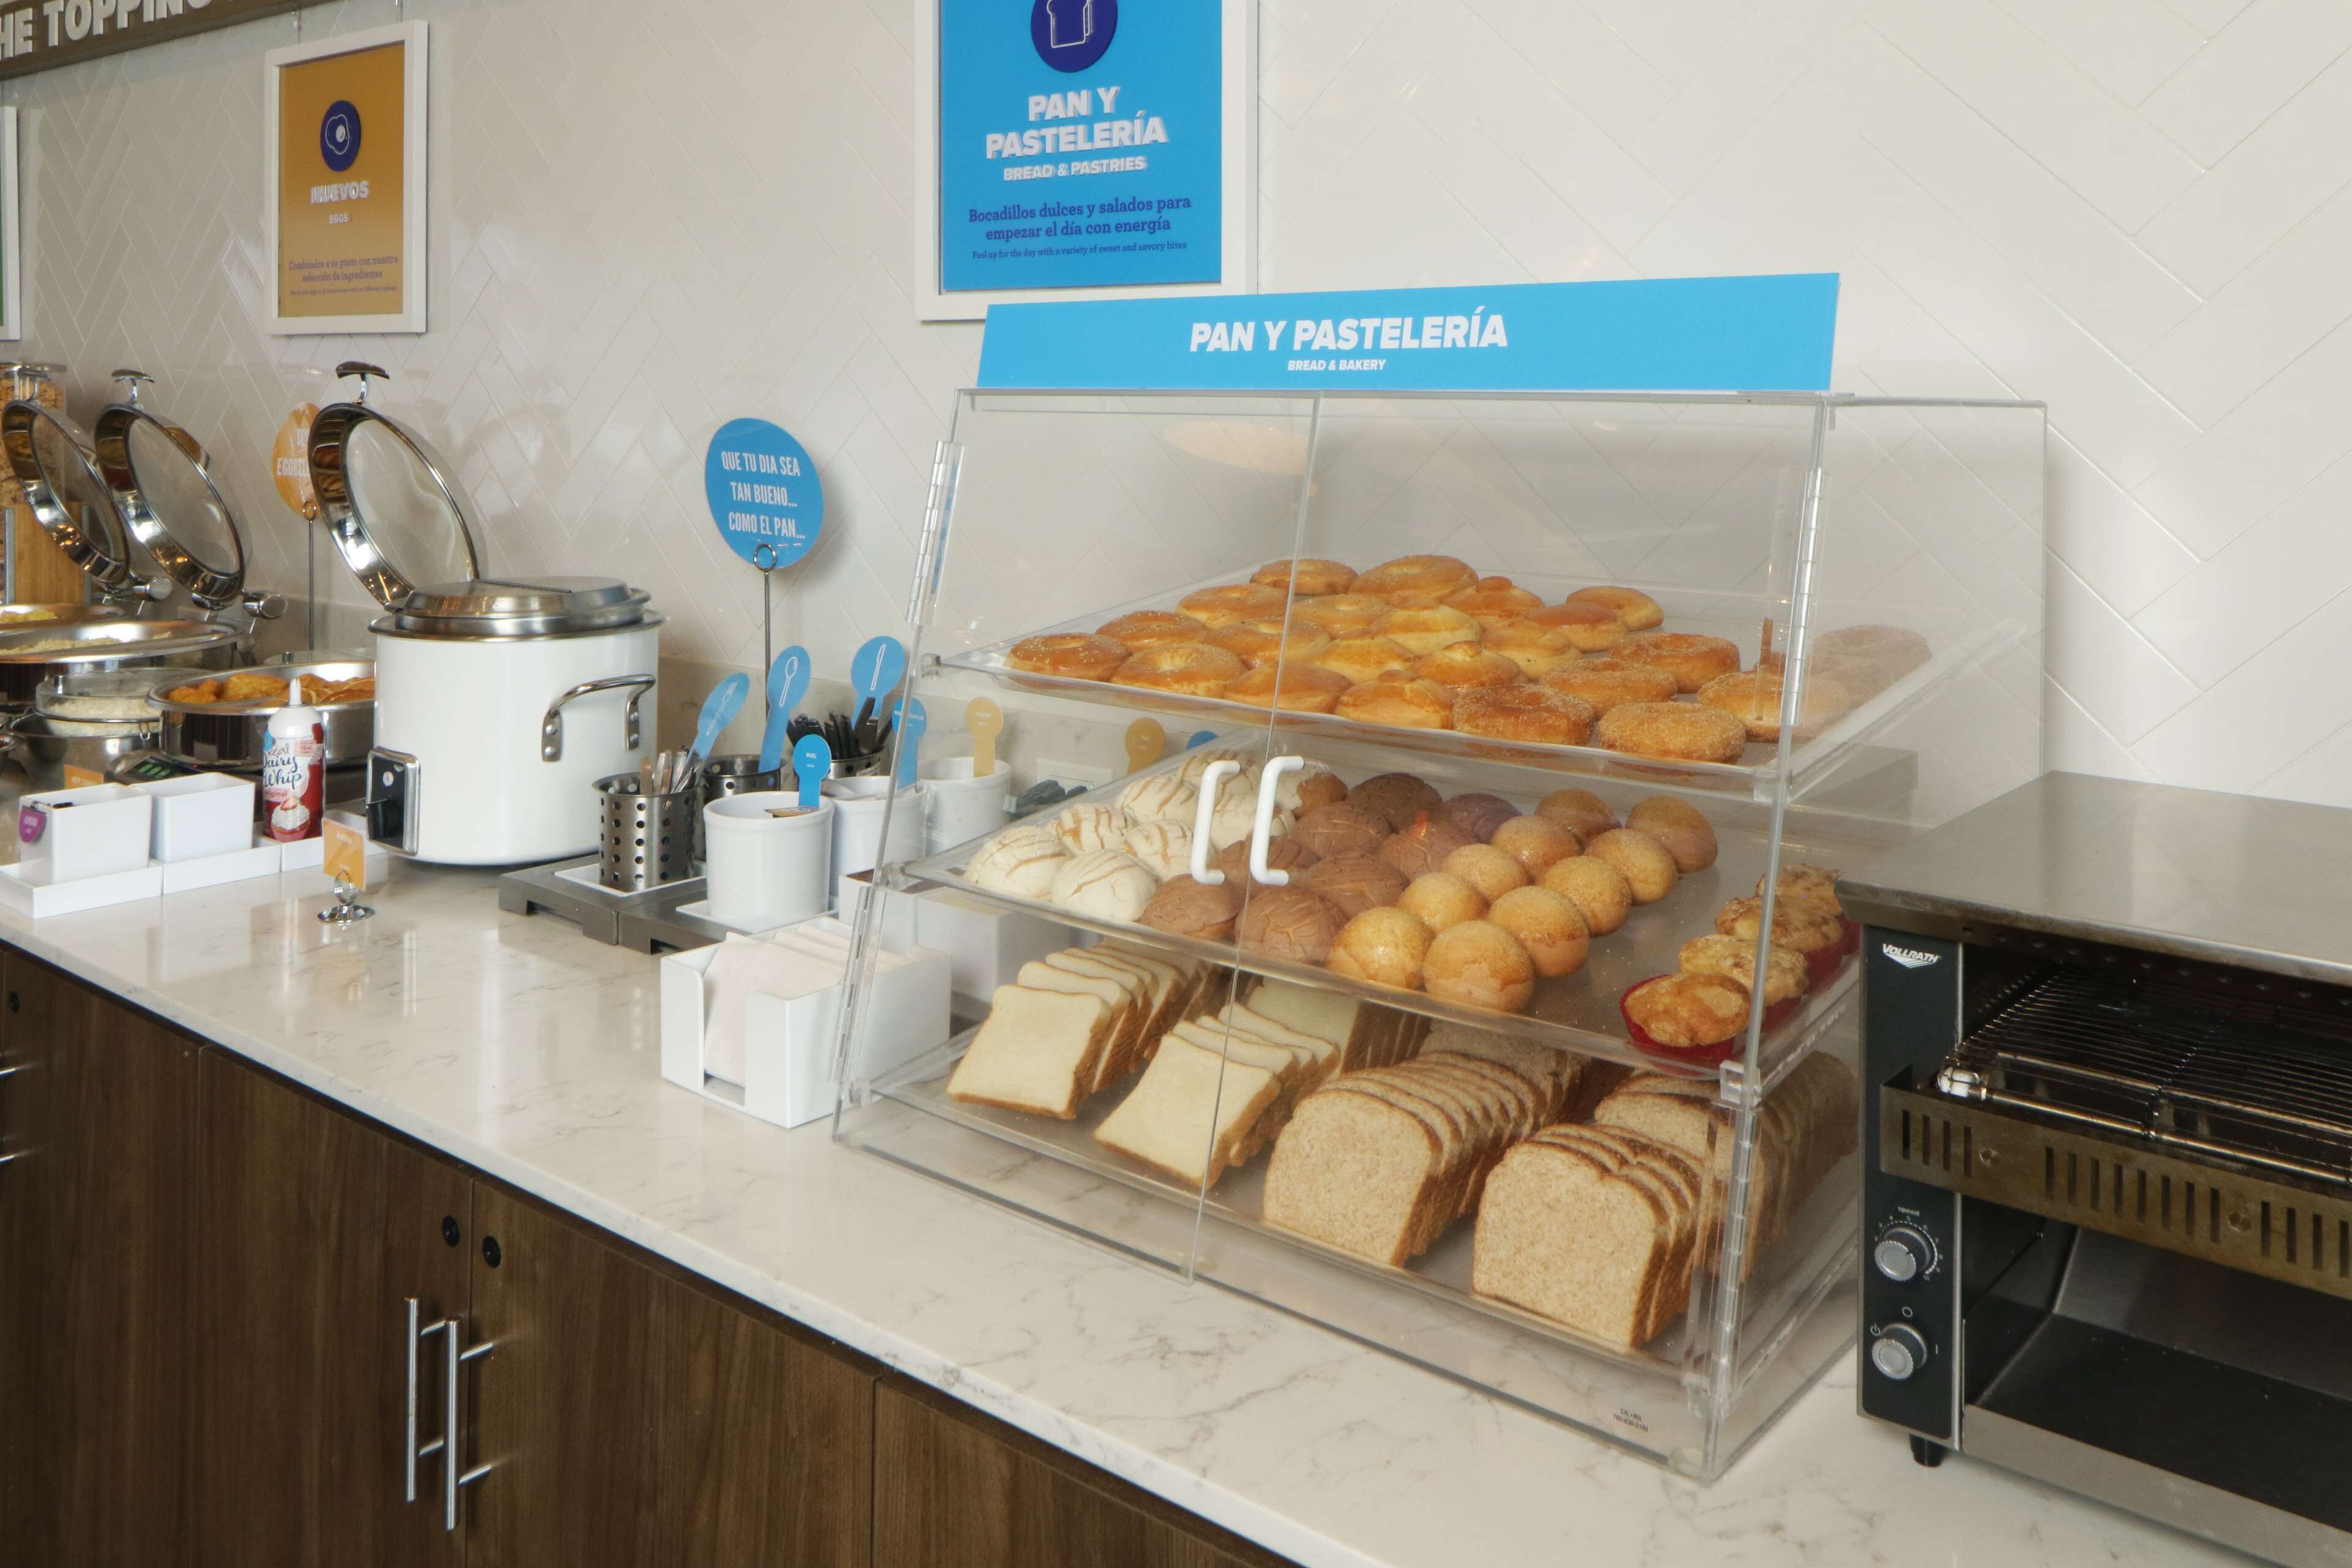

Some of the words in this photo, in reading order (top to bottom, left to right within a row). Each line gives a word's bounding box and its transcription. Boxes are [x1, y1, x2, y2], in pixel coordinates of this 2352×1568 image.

[43, 0, 216, 47] TOPPI
[1029, 89, 1091, 121] PAN
[1097, 86, 1120, 114] Y
[986, 110, 1169, 159] PASTELERÍA
[1004, 164, 1055, 181] BREAD
[1058, 162, 1068, 176] &
[1071, 156, 1147, 175] PASTRIES
[311, 179, 371, 205] HUEVOS
[330, 213, 349, 224] EGGS
[969, 205, 1036, 222] Bocadillos
[1039, 202, 1084, 217] dulces
[1087, 204, 1096, 218] y
[1099, 196, 1153, 213] salados
[1157, 197, 1191, 213] para
[986, 228, 1042, 243] empezar
[1045, 221, 1057, 236] el
[1061, 220, 1082, 235] día
[1086, 223, 1111, 234] con
[1115, 215, 1170, 235] energía
[1011, 249, 1022, 257] the
[1023, 248, 1036, 258] day
[1038, 247, 1054, 255] with
[1061, 246, 1088, 255] variety
[1089, 244, 1097, 253] of
[1122, 243, 1137, 251] and
[1138, 243, 1165, 252] savory
[1167, 241, 1187, 249] bites
[1190, 322, 1255, 352] PAN
[1264, 320, 1287, 351] Y
[1293, 306, 1508, 351] PASTELERÍA
[1287, 360, 1327, 371] BREAD
[1329, 360, 1336, 371] &
[1339, 358, 1386, 371] BAKERY
[722, 451, 742, 471] QUE
[742, 453, 756, 472] TU
[759, 454, 778, 475] DIA
[779, 456, 801, 477] SEA
[730, 481, 751, 502] TAN
[753, 484, 797, 507] BUENO...
[728, 511, 757, 533] COMO
[760, 516, 772, 535] EL
[774, 518, 805, 539] PAN...
[264, 769, 301, 790] Whip
[1882, 943, 1939, 963] VOLLRATH
[1898, 1206, 1920, 1216] speed
